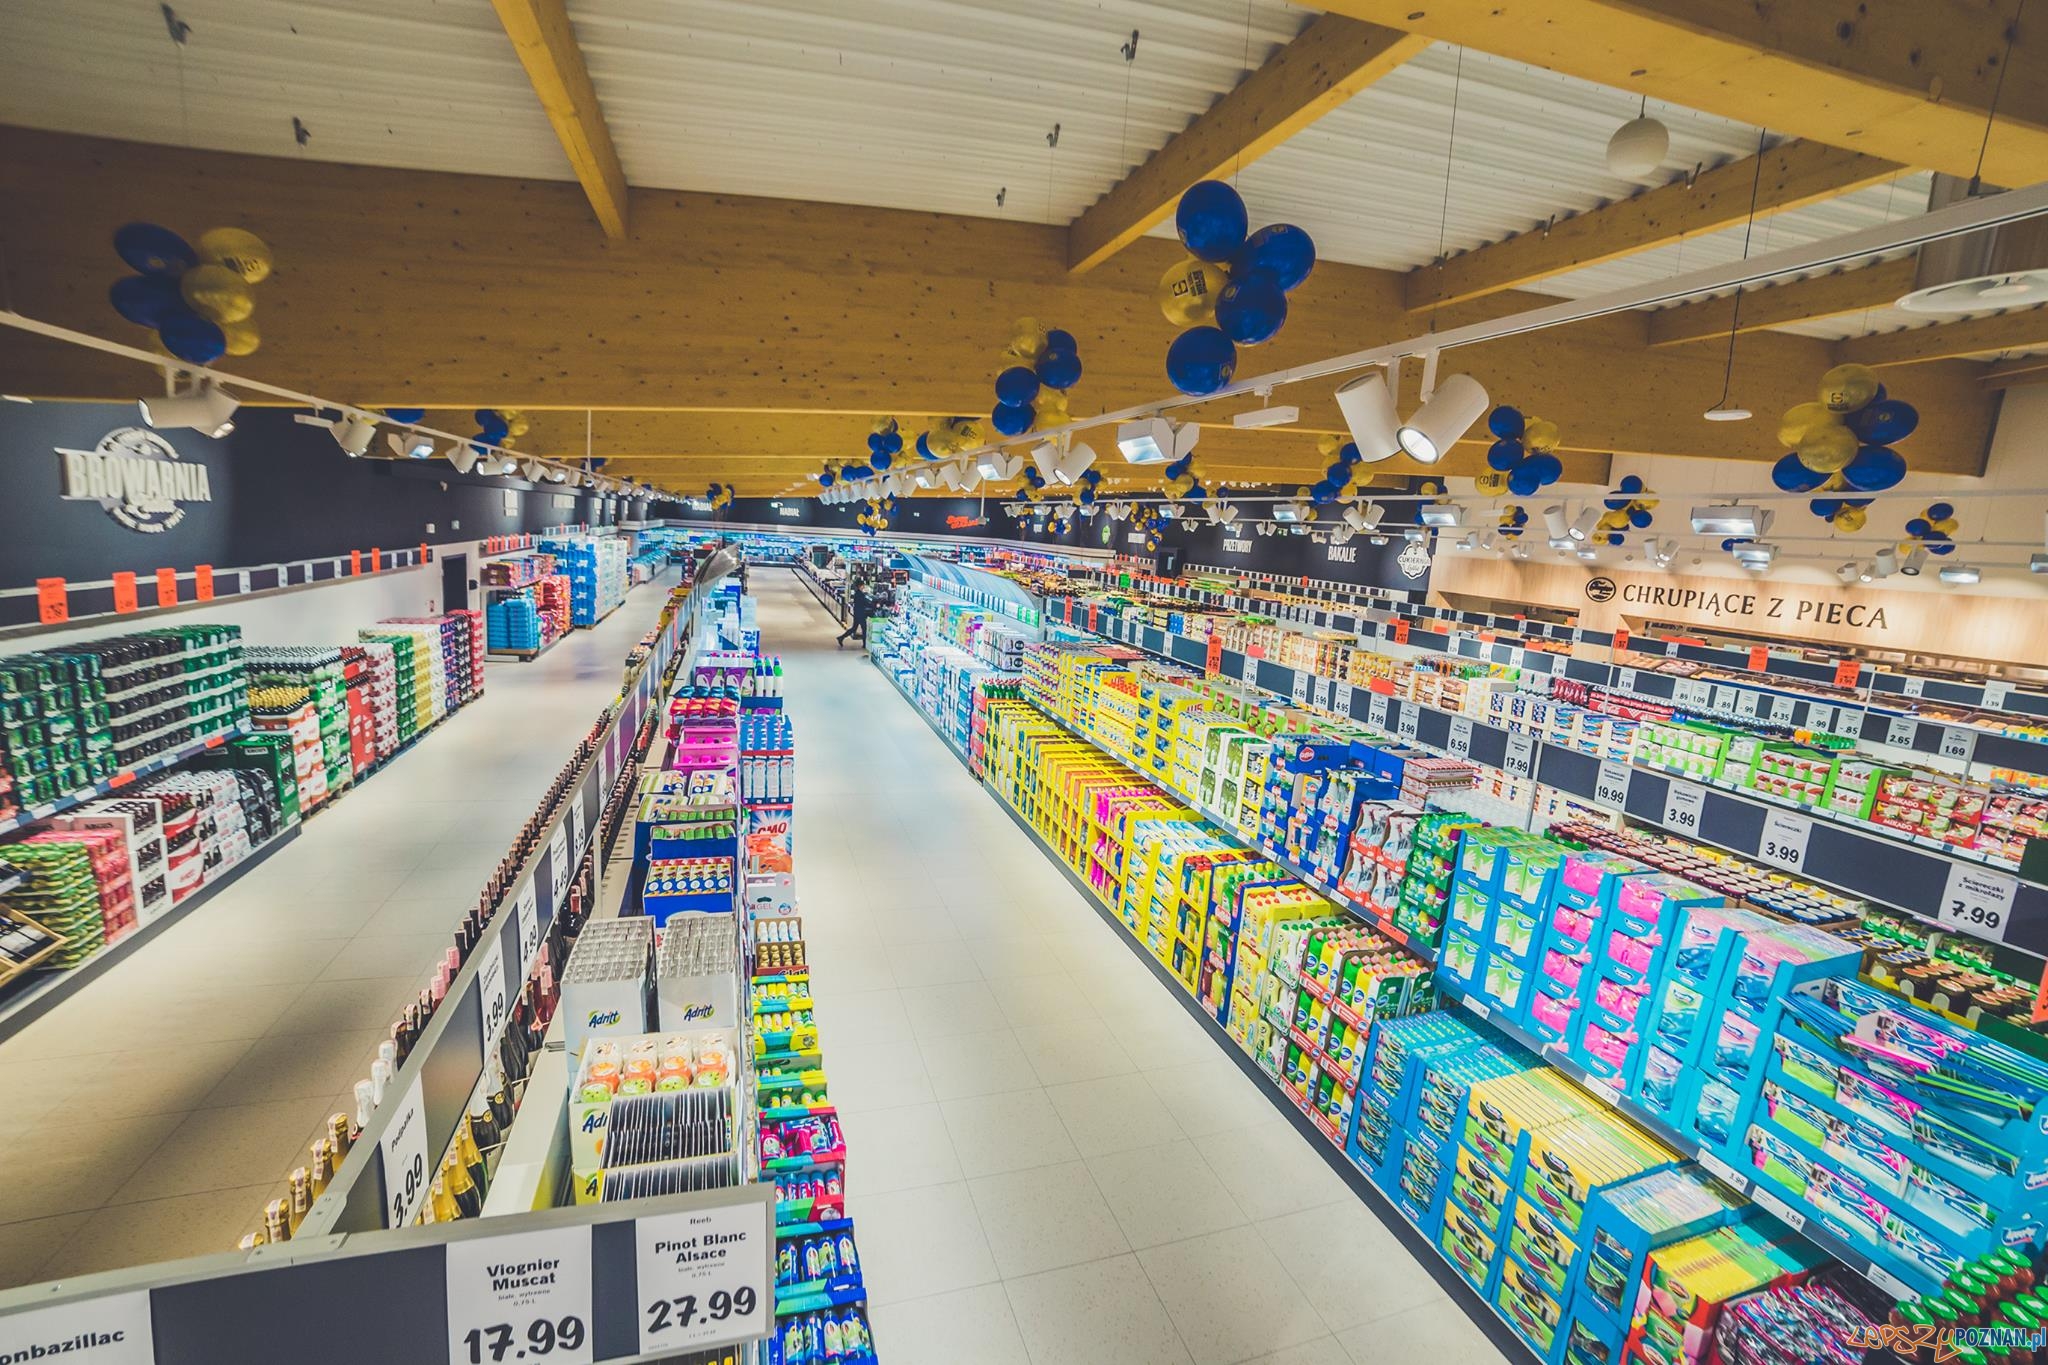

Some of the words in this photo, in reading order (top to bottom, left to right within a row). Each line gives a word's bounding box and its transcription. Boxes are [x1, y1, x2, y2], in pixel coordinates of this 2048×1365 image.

[69, 454, 211, 501] BROWARNIA
[1328, 545, 1356, 563] BAKALIE
[1623, 584, 1756, 616] CHRUPIĄCE
[1767, 597, 1784, 618] Z
[1796, 600, 1888, 630] PIECA
[1371, 712, 1384, 725] 7.99
[1772, 711, 1790, 722] 4.35
[1400, 722, 1415, 735] 3.99
[1450, 738, 1468, 752] 6.59
[1889, 733, 1911, 746] 2.65
[1945, 744, 1966, 757] 1.69
[1506, 756, 1528, 773] 17.99
[1598, 785, 1624, 804] 19.99
[1889, 795, 1919, 809] MIKADO
[1668, 808, 1695, 827] 3.99
[1883, 818, 1913, 832] MIKADO
[1766, 841, 1800, 864] 3.99
[1952, 900, 2000, 929] 7.99
[486, 992, 503, 1042] 3.99
[589, 1008, 620, 1028] Adritt
[684, 1003, 714, 1021] Adritt
[394, 1153, 423, 1228] 3.99
[655, 1237, 697, 1254] Pinot
[704, 1231, 747, 1246] Blanc
[676, 1248, 726, 1264] Alsace
[487, 1258, 560, 1277] Viognier
[493, 1272, 556, 1292] Muscat
[647, 1286, 757, 1334] 27.99
[463, 1315, 585, 1365] 17.99
